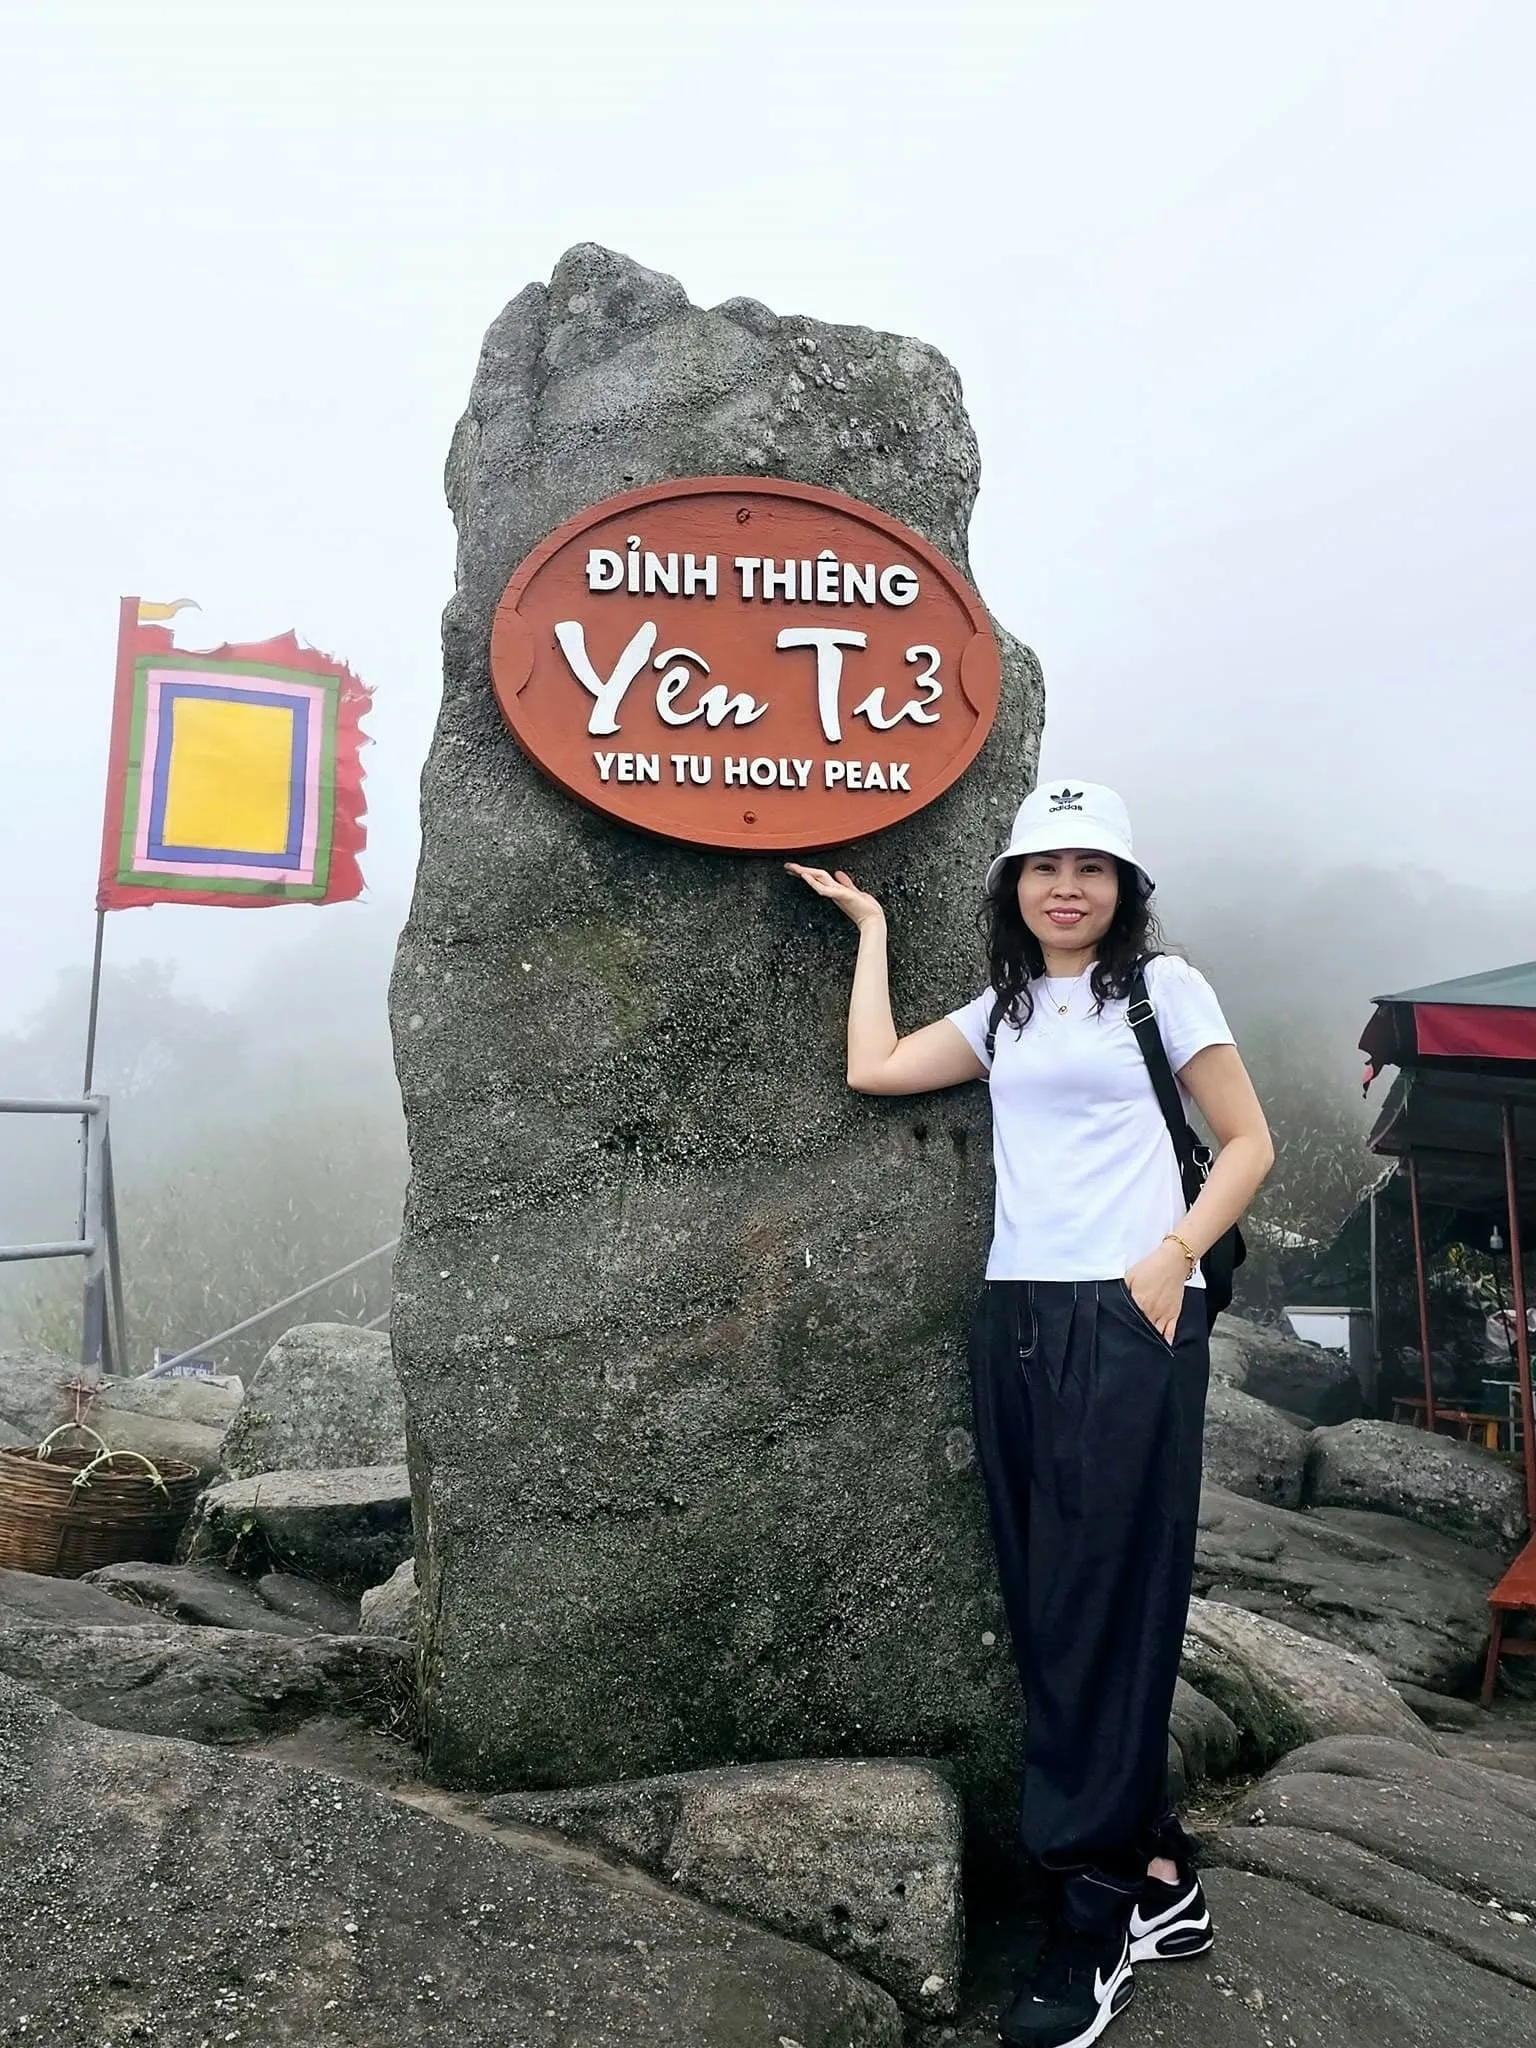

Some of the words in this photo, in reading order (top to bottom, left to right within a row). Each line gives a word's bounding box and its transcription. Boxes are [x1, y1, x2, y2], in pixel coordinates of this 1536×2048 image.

[585, 535, 718, 597] ĐỈNH
[734, 549, 920, 606] THIÊNG
[554, 620, 769, 736] Yên
[593, 751, 660, 782] YEN
[670, 754, 712, 784] TU
[724, 756, 813, 787] HOLY
[824, 760, 913, 791] PEAK
[1049, 804, 1083, 813] adidas
